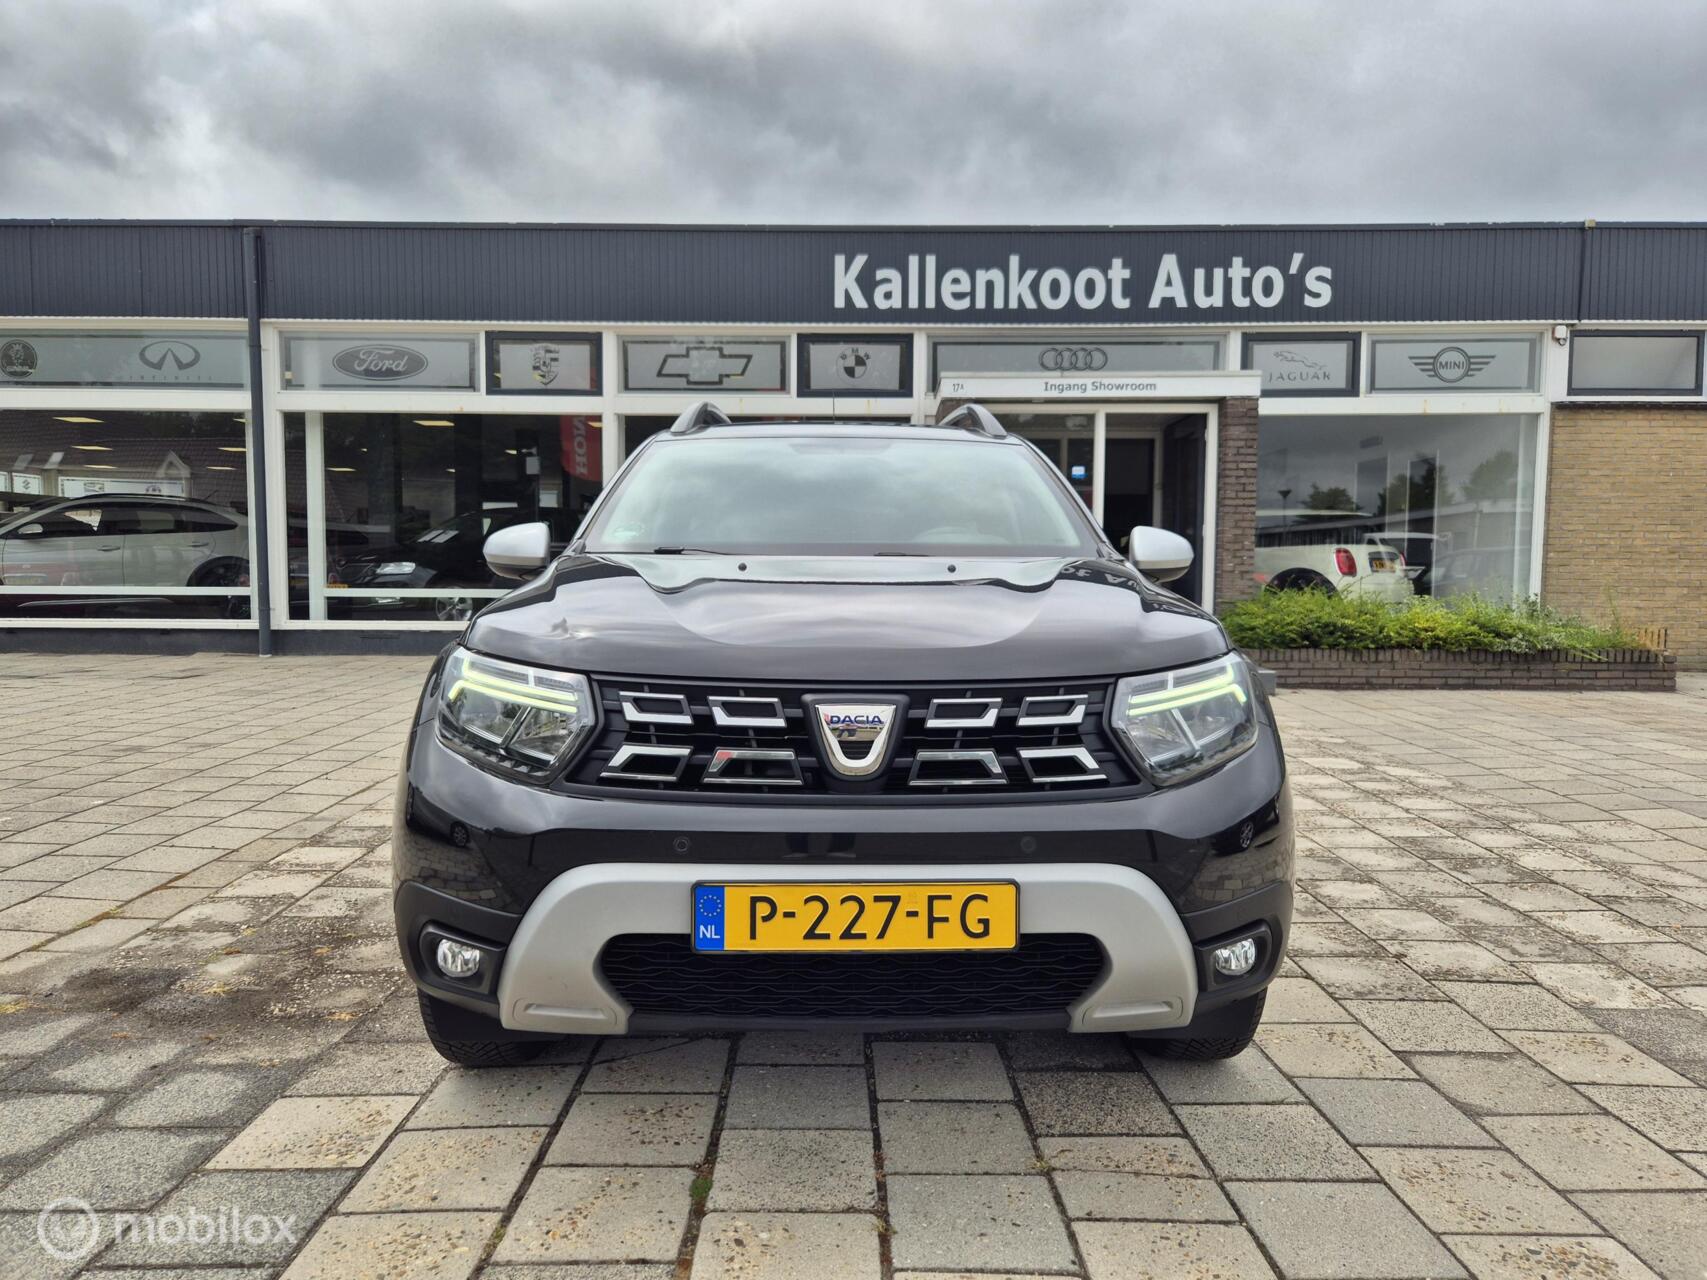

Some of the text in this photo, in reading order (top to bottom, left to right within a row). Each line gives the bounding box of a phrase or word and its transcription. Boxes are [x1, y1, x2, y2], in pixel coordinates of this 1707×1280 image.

[833, 252, 1334, 310] Kallenkoot Auto's
[353, 349, 408, 373] Ford
[1438, 360, 1466, 371] MINI
[1268, 370, 1331, 383] JAGUAR
[1043, 380, 1157, 394] Ingang Showroom
[830, 715, 884, 725] DACIA
[749, 893, 991, 941] P-227-FG
[699, 924, 721, 939] NL
